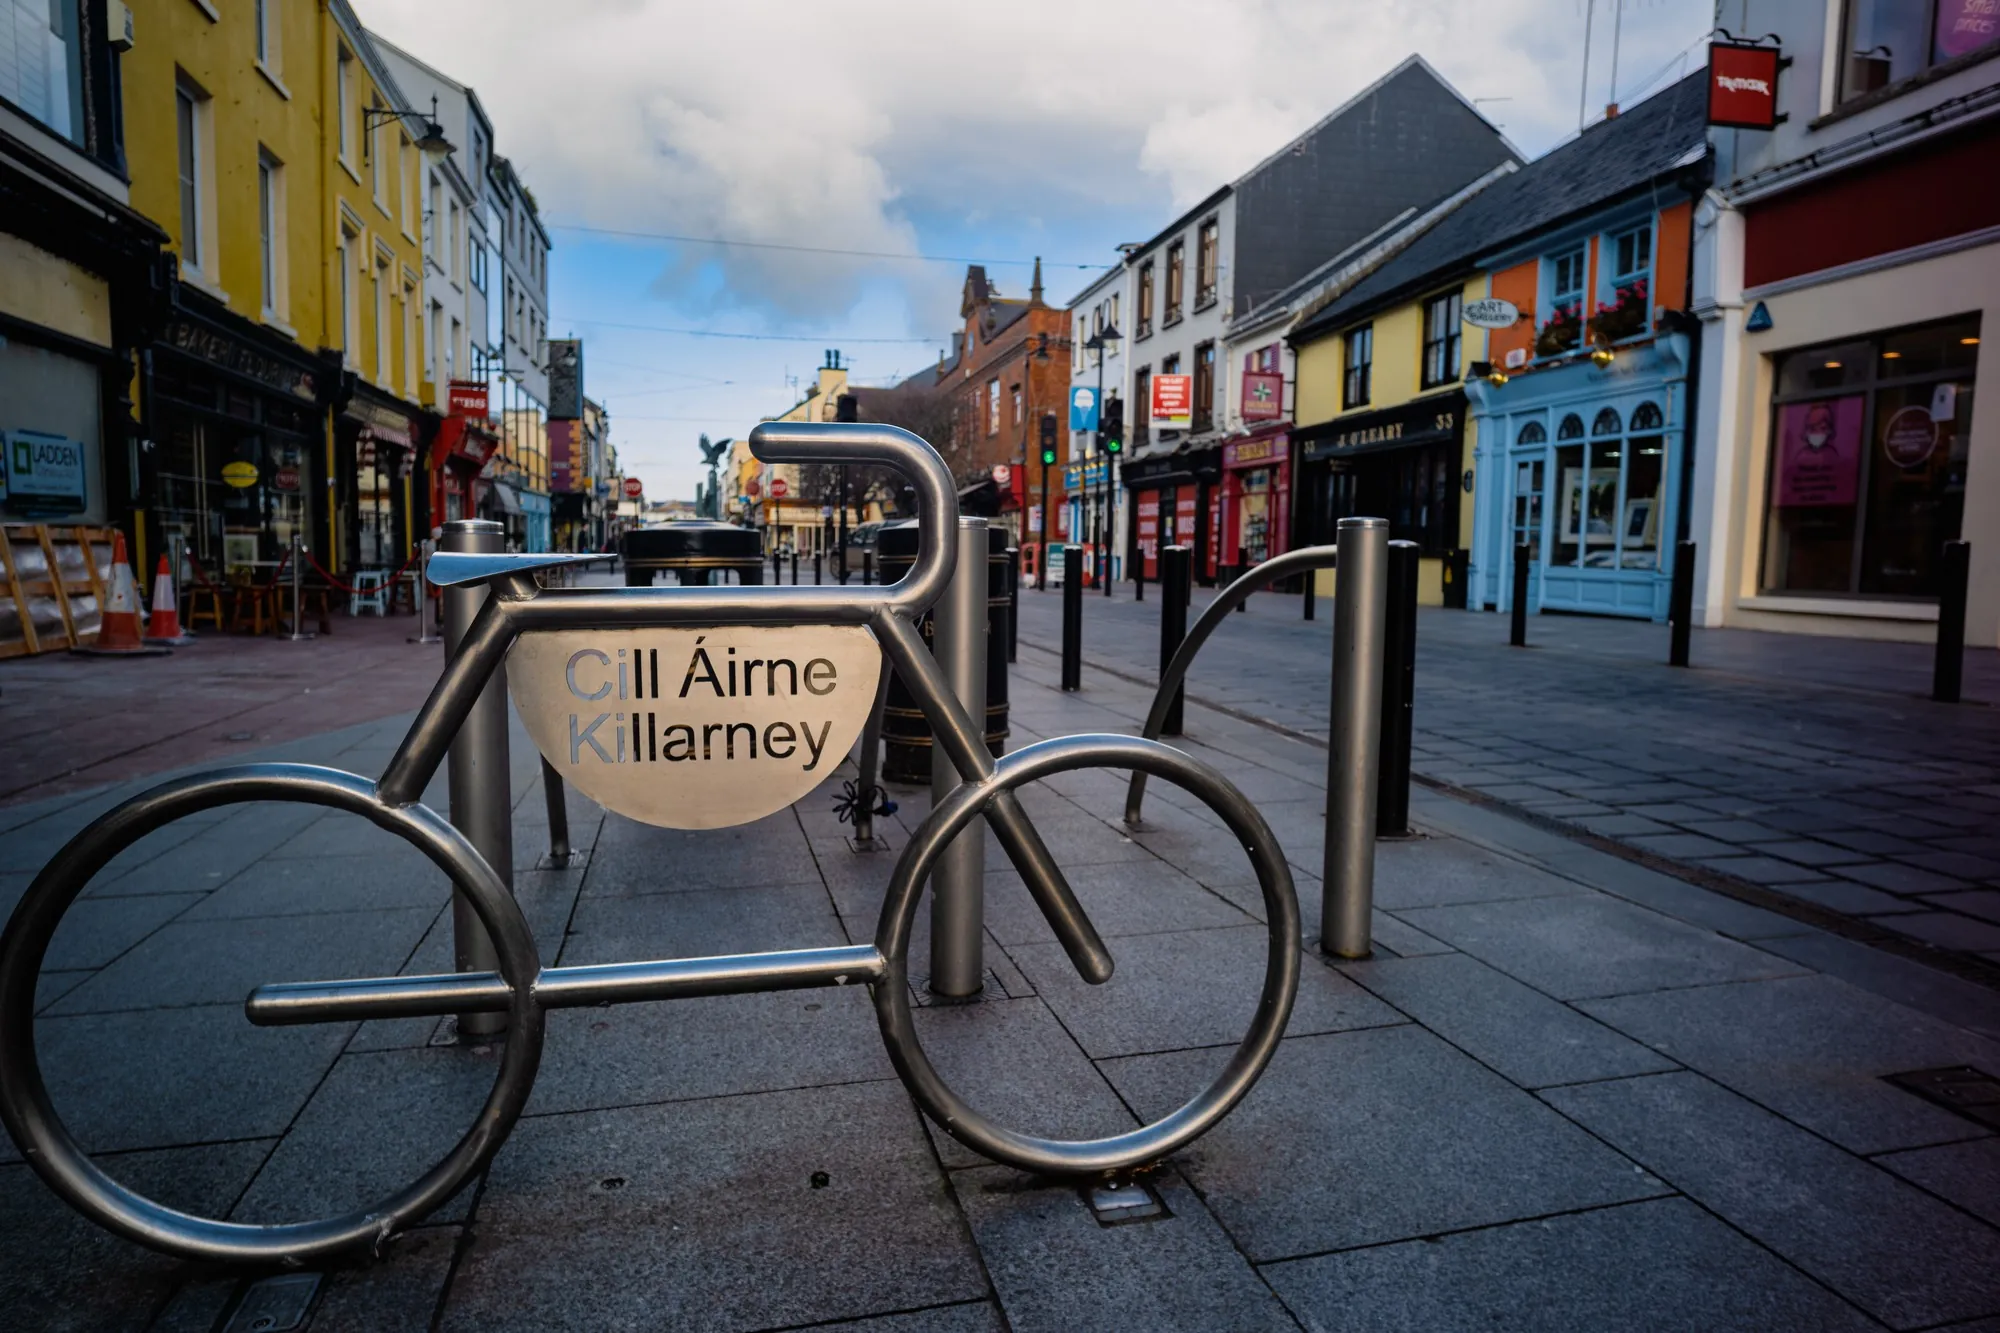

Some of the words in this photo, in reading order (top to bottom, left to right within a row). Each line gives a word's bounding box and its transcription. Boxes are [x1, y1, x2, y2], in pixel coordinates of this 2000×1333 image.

[1480, 300, 1504, 312] ART
[625, 483, 641, 491] STOP
[771, 483, 787, 491] STOP
[565, 648, 659, 701] Cill
[678, 636, 837, 698] Áirne
[569, 712, 832, 771] Killarney
